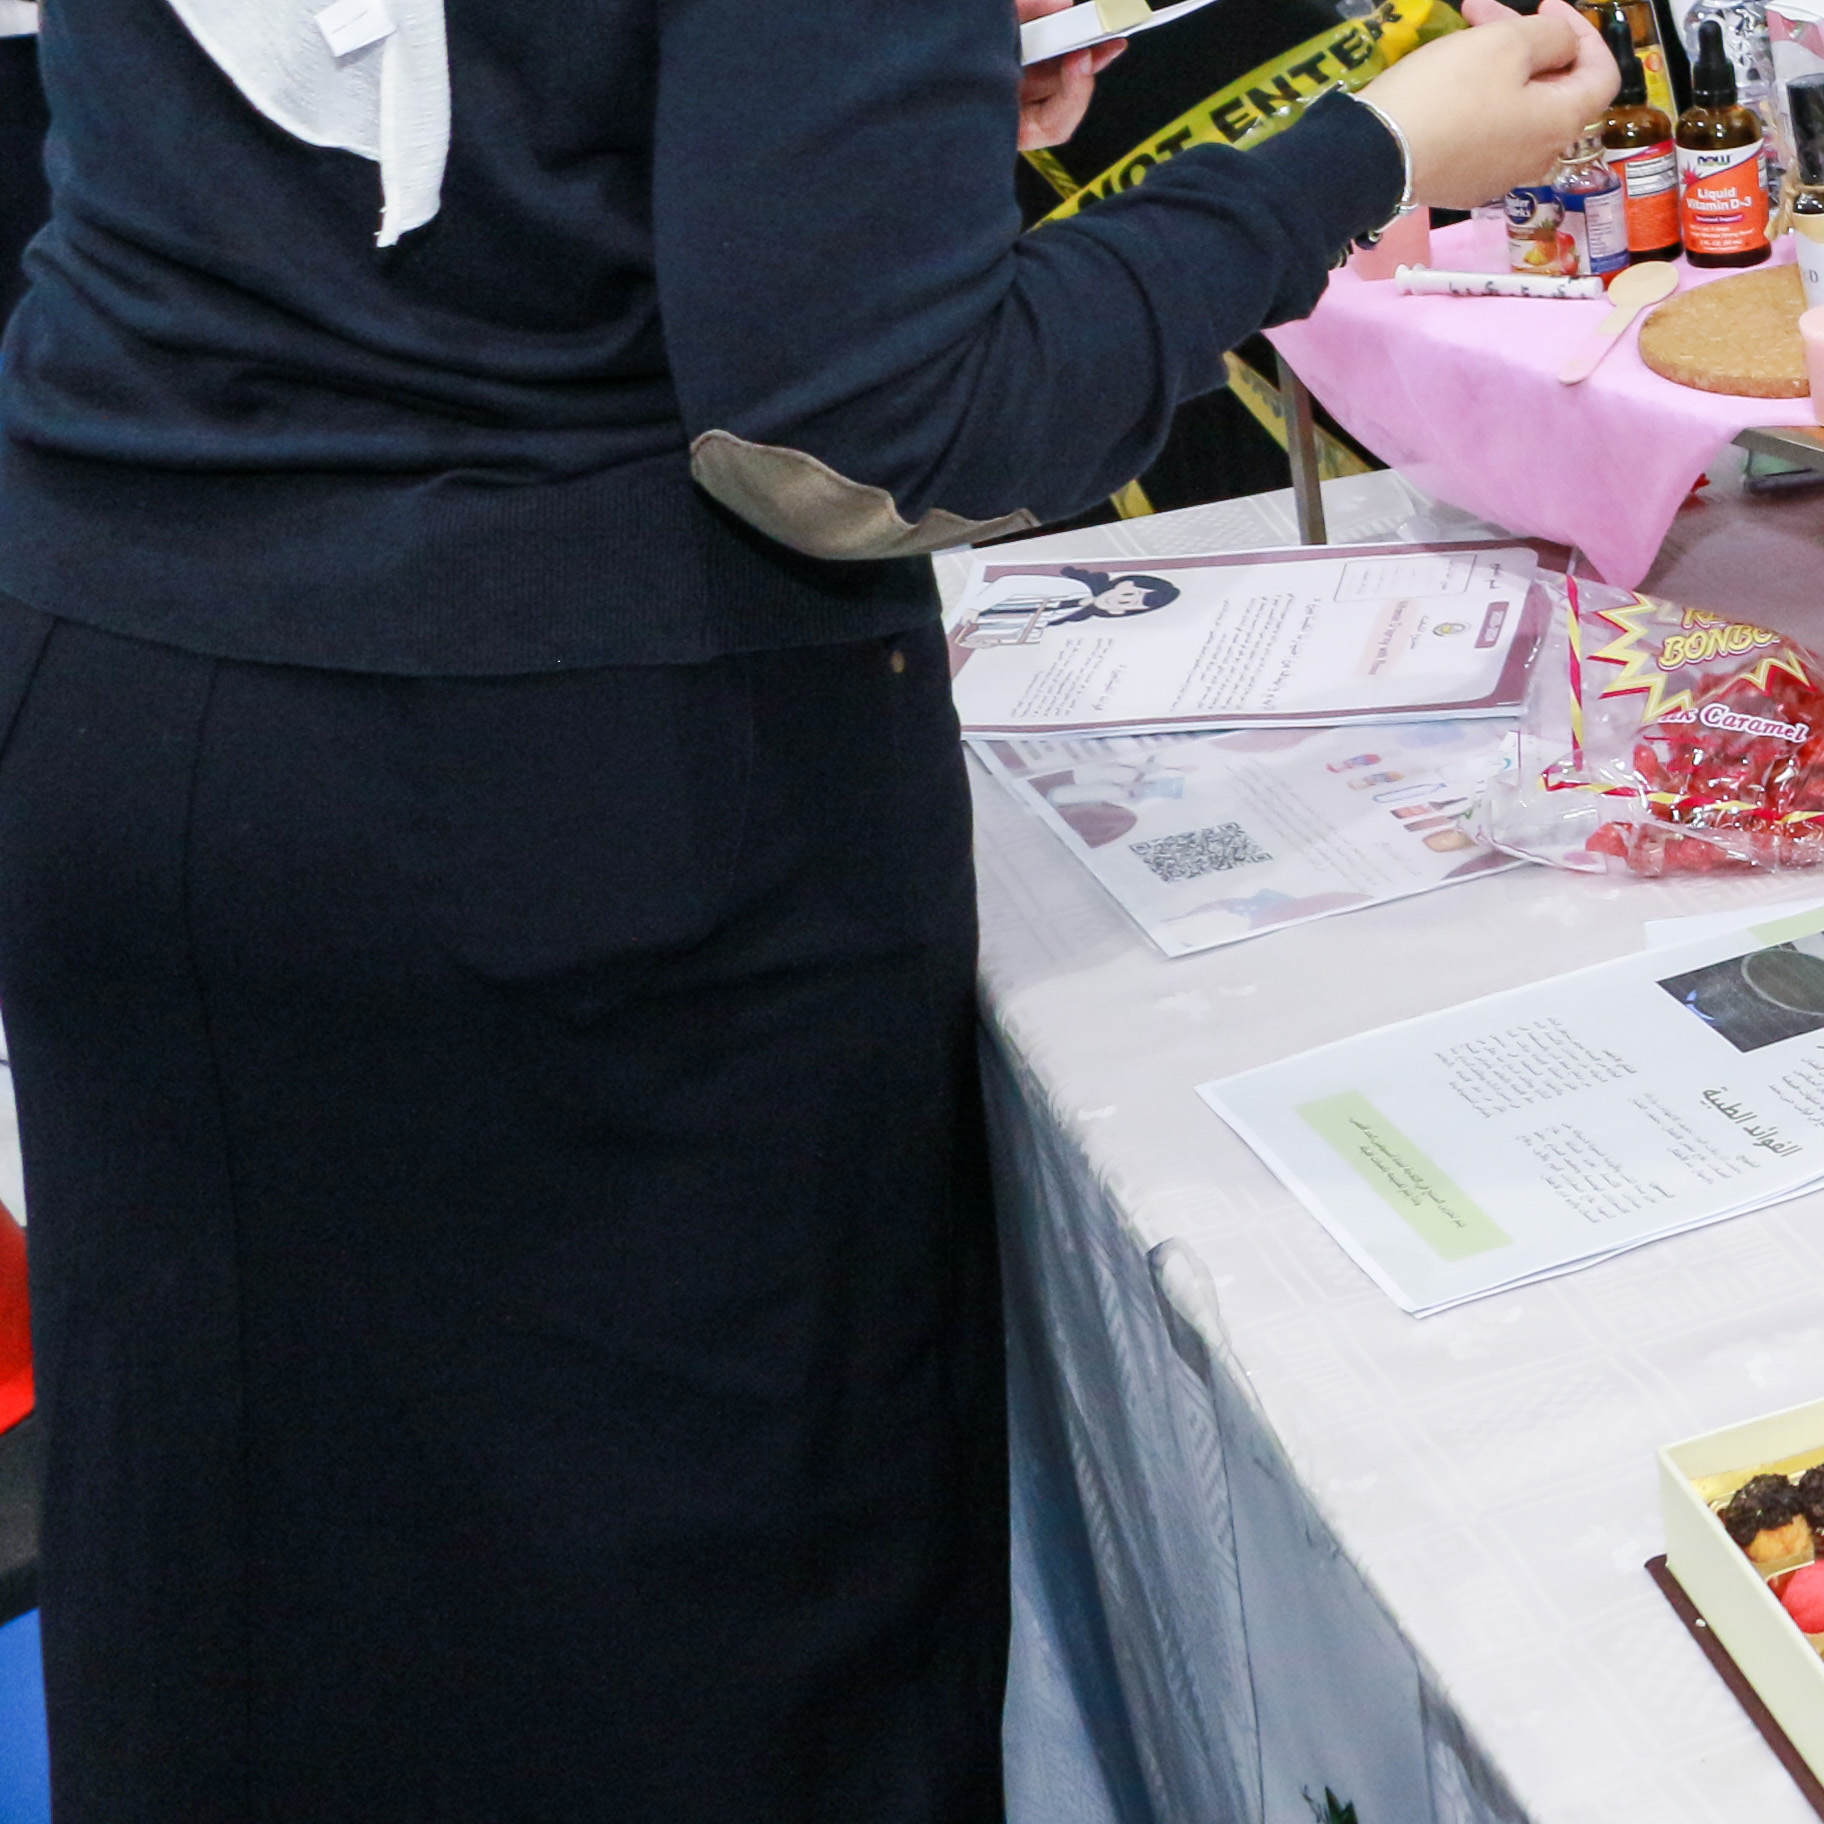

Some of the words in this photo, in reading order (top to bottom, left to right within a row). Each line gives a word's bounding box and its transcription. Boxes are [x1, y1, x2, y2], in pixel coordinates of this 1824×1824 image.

[1686, 196, 1729, 211] Vitamin
[1697, 186, 1738, 201] Liquid
[1656, 624, 1781, 672] BONBO
[1701, 703, 1810, 743] Caramel
[1700, 1086, 1758, 1125] الطبية
[1742, 1125, 1803, 1158] الفوائد
